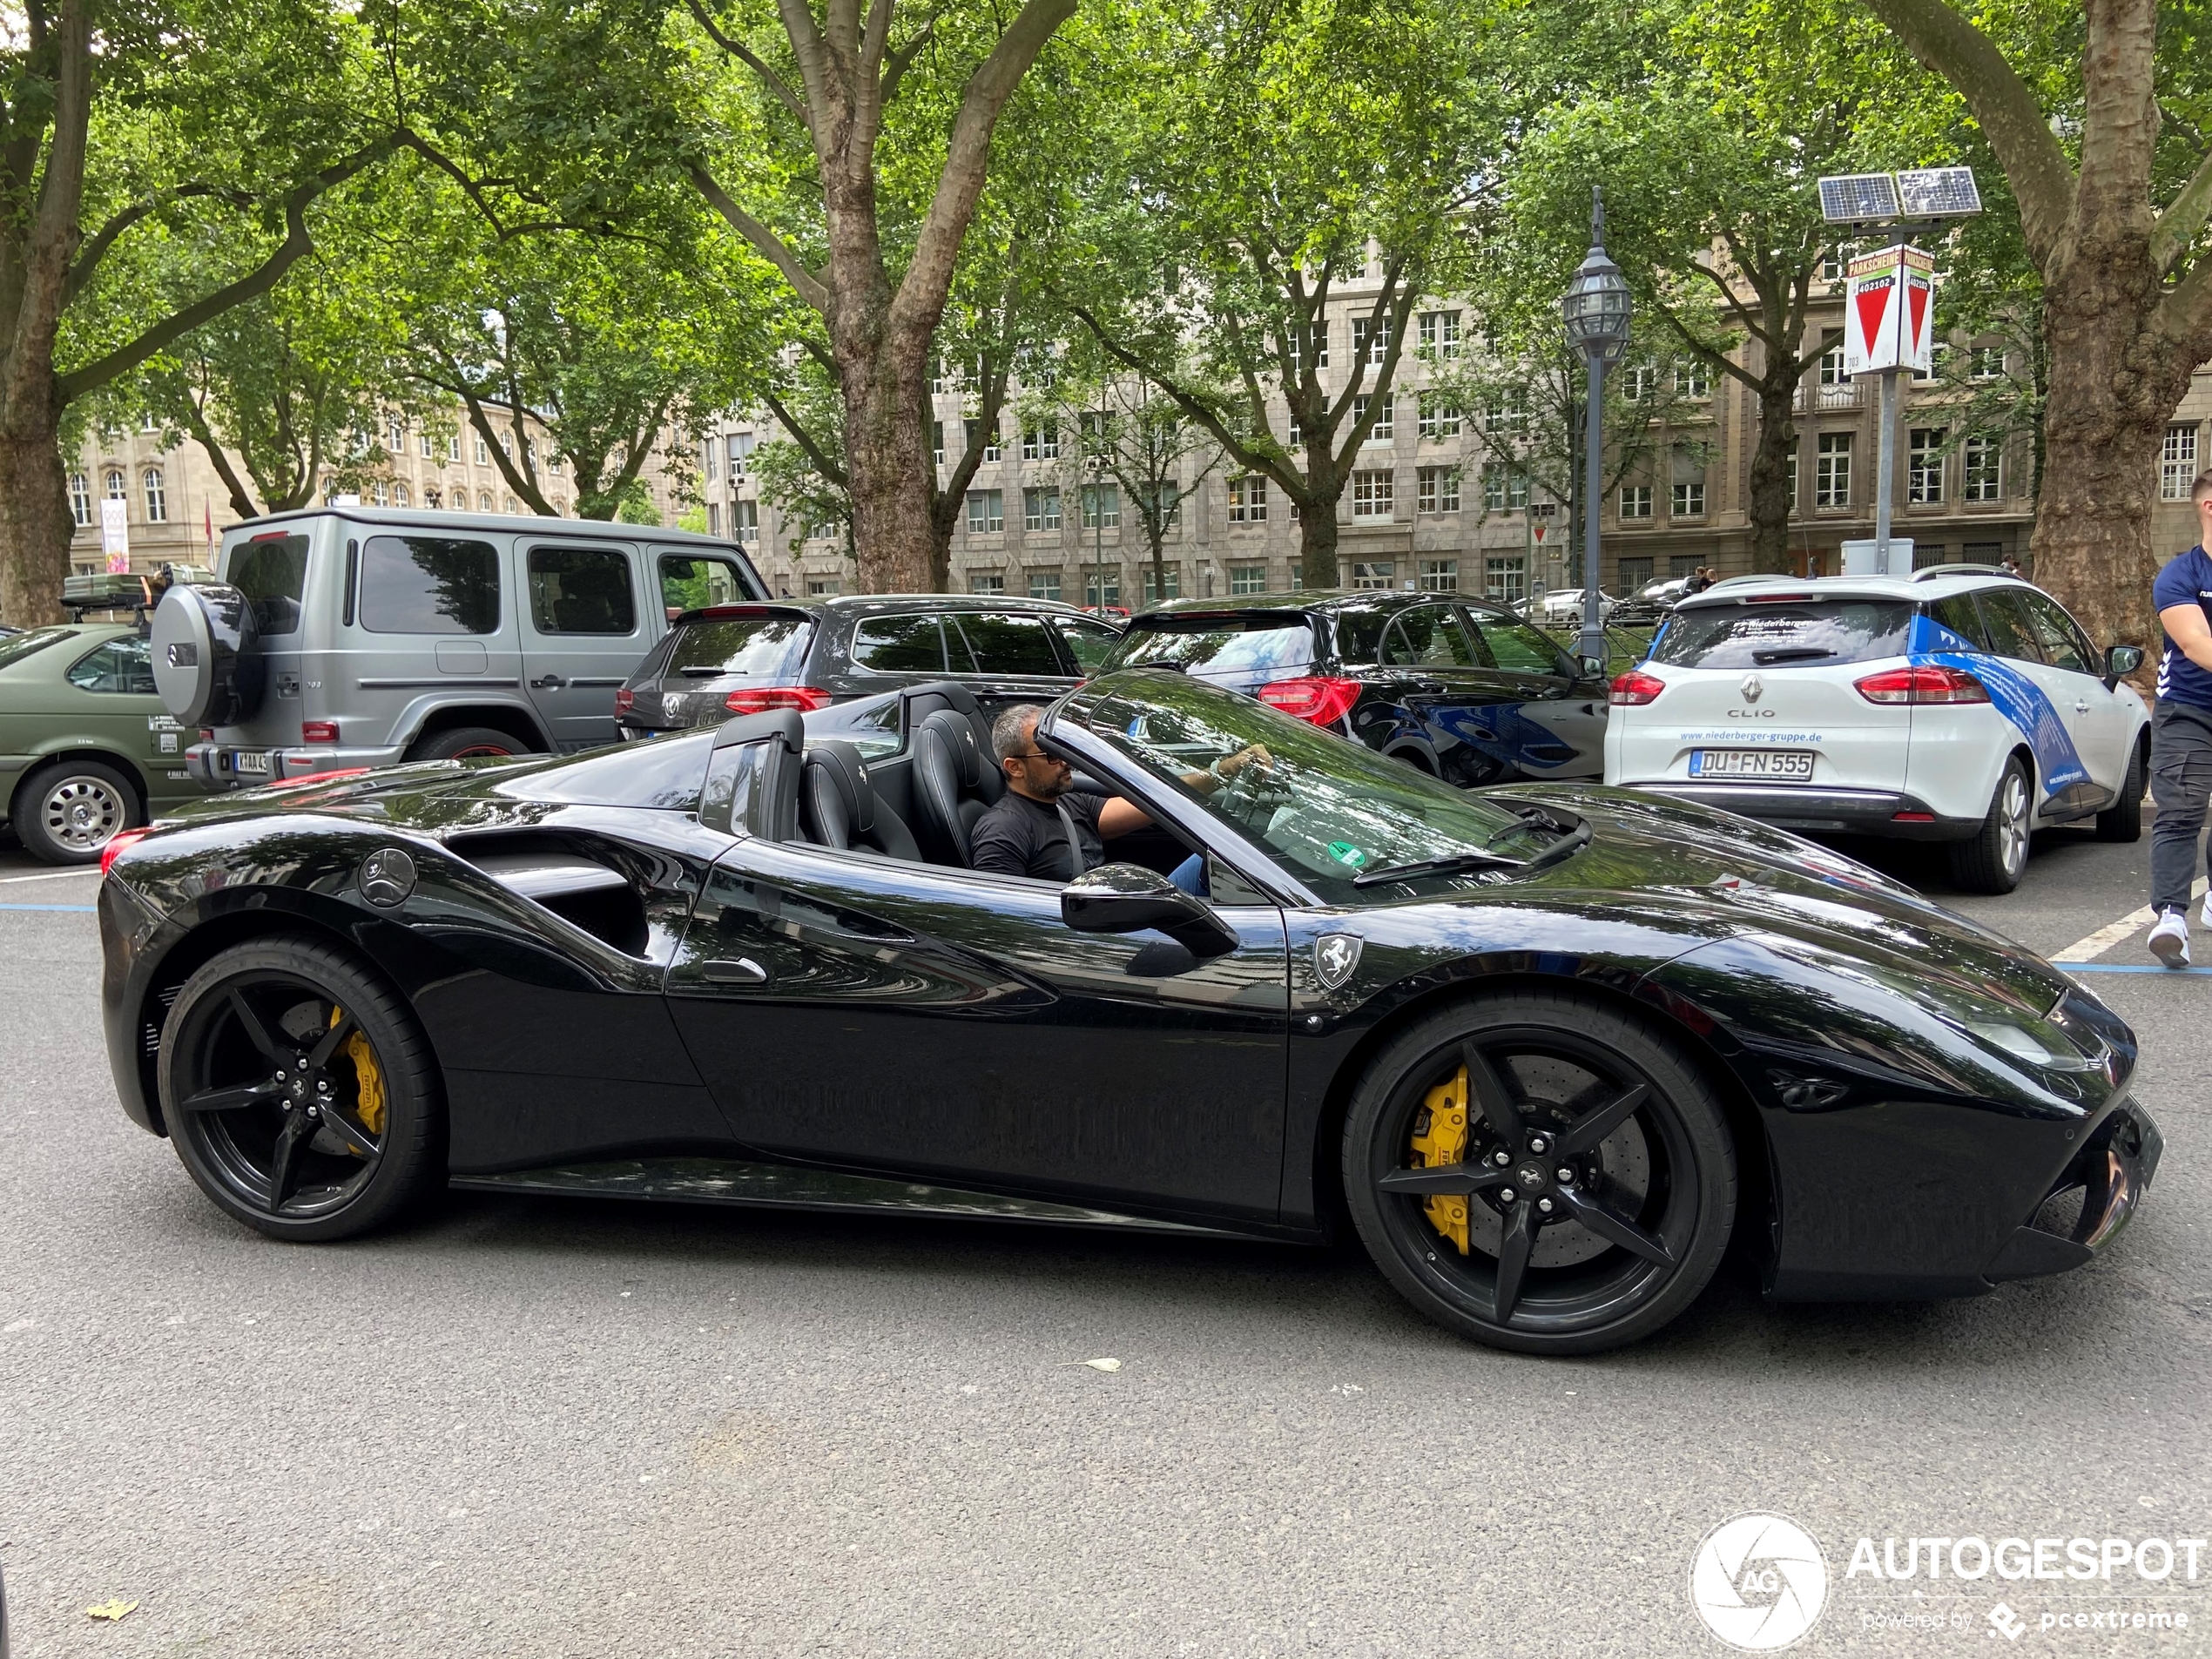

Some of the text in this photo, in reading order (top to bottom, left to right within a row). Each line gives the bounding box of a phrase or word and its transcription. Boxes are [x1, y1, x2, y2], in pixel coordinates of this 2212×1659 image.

[1849, 252, 1899, 277] PARKSCHEINE
[1905, 251, 1933, 272] PARKSCHEINE
[1858, 278, 1891, 293] 402102
[1910, 278, 1928, 291] 402102
[1848, 356, 1859, 368] 703
[1749, 617, 1810, 628] Niederberger
[1680, 731, 1822, 743] www.niederberger-gruppe.de
[239, 754, 245, 770] K
[248, 754, 258, 770] AA
[1702, 752, 1729, 772] DU
[1740, 753, 1768, 772] FN
[1771, 754, 1811, 773] 555
[1332, 843, 1348, 854] 4
